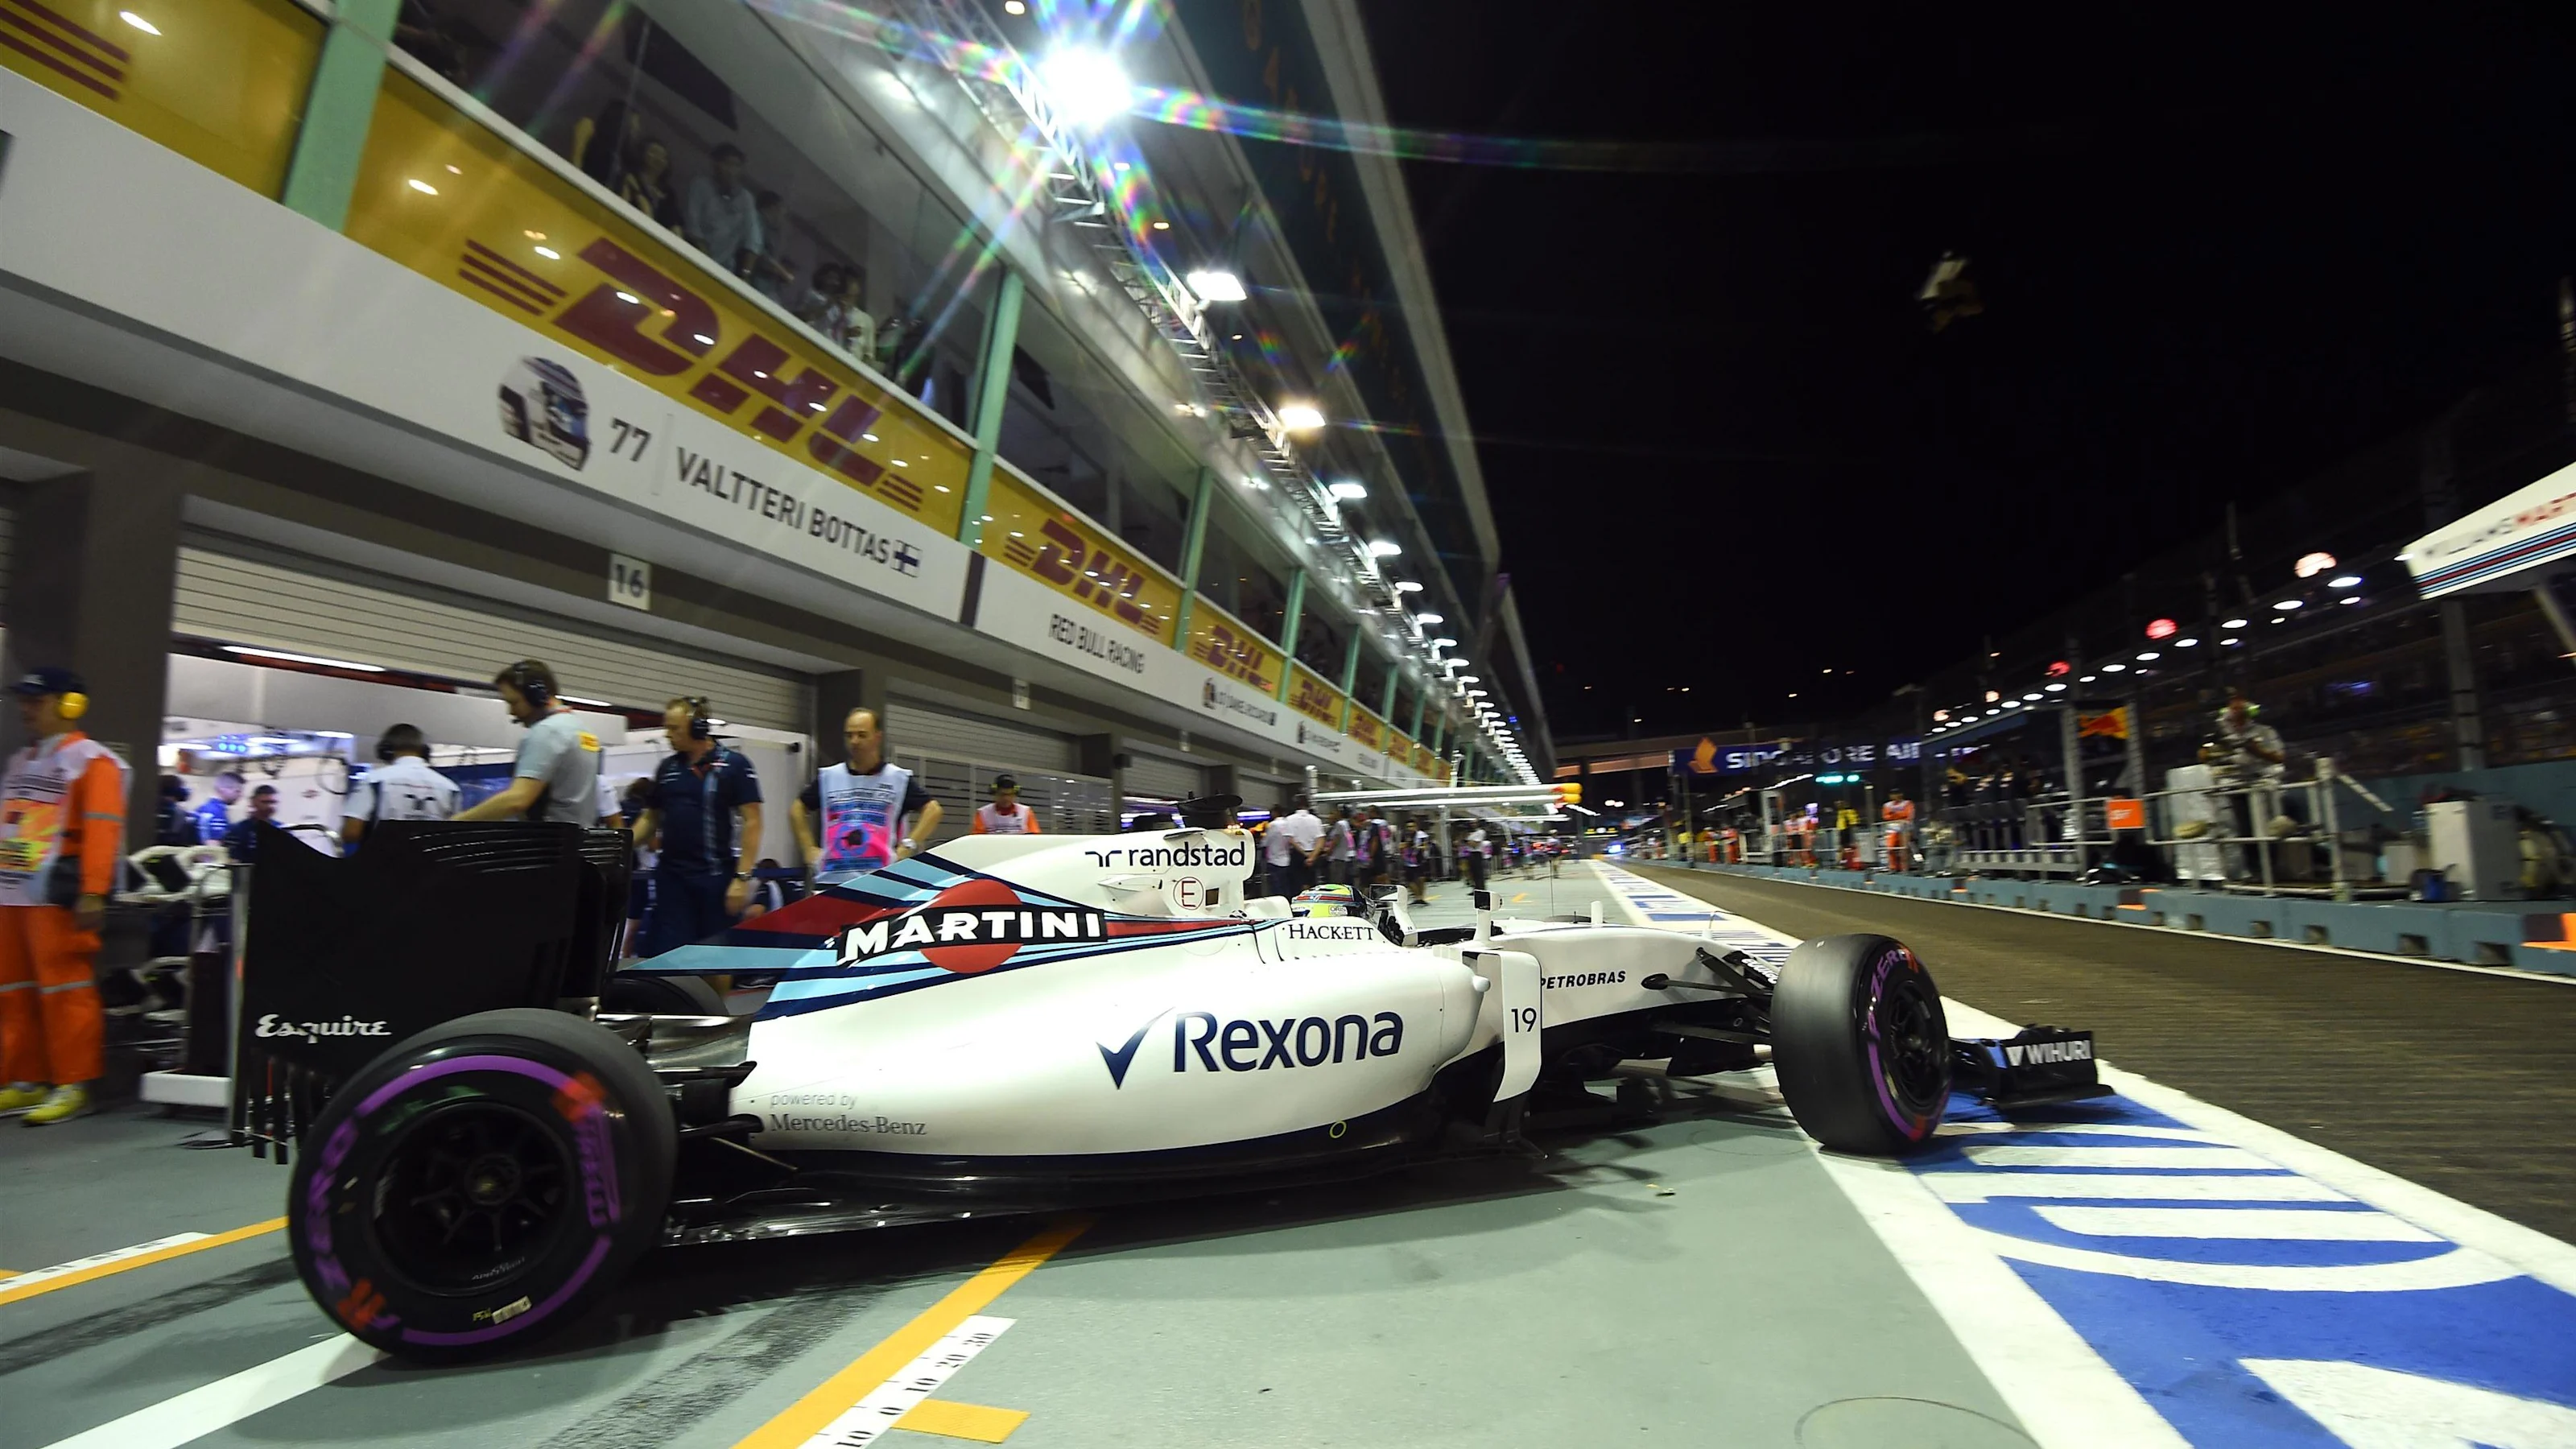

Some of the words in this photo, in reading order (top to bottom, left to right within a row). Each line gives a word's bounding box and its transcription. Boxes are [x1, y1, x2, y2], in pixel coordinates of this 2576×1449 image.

[554, 237, 884, 487] DHL
[610, 417, 651, 462] 77
[677, 447, 805, 530] VALTTERI
[807, 508, 890, 564] BOTTAS
[617, 564, 644, 598] 16
[1030, 518, 1146, 625] DHL
[1049, 613, 1077, 645] RED
[1076, 626, 1106, 658] BULL
[1107, 640, 1146, 674] RACING
[1208, 625, 1266, 686] DHL
[1129, 840, 1245, 867] randstad
[1181, 880, 1197, 907] E
[836, 910, 1101, 966] MARTINI
[1289, 924, 1373, 940] HACKETT
[1541, 970, 1626, 989] PETROBRAS
[255, 1013, 393, 1044] Esquire
[1511, 1007, 1537, 1033] 19
[1173, 1011, 1404, 1073] Rexona
[2025, 1039, 2092, 1065] WIHURI
[770, 1093, 836, 1108] powered
[840, 1093, 859, 1110] by
[769, 1113, 927, 1135] Mercedes-Benz
[835, 1430, 874, 1448] 10
[878, 1406, 904, 1416] 0
[903, 1377, 939, 1392] 10
[935, 1354, 968, 1368] 20
[962, 1332, 994, 1347] 30
